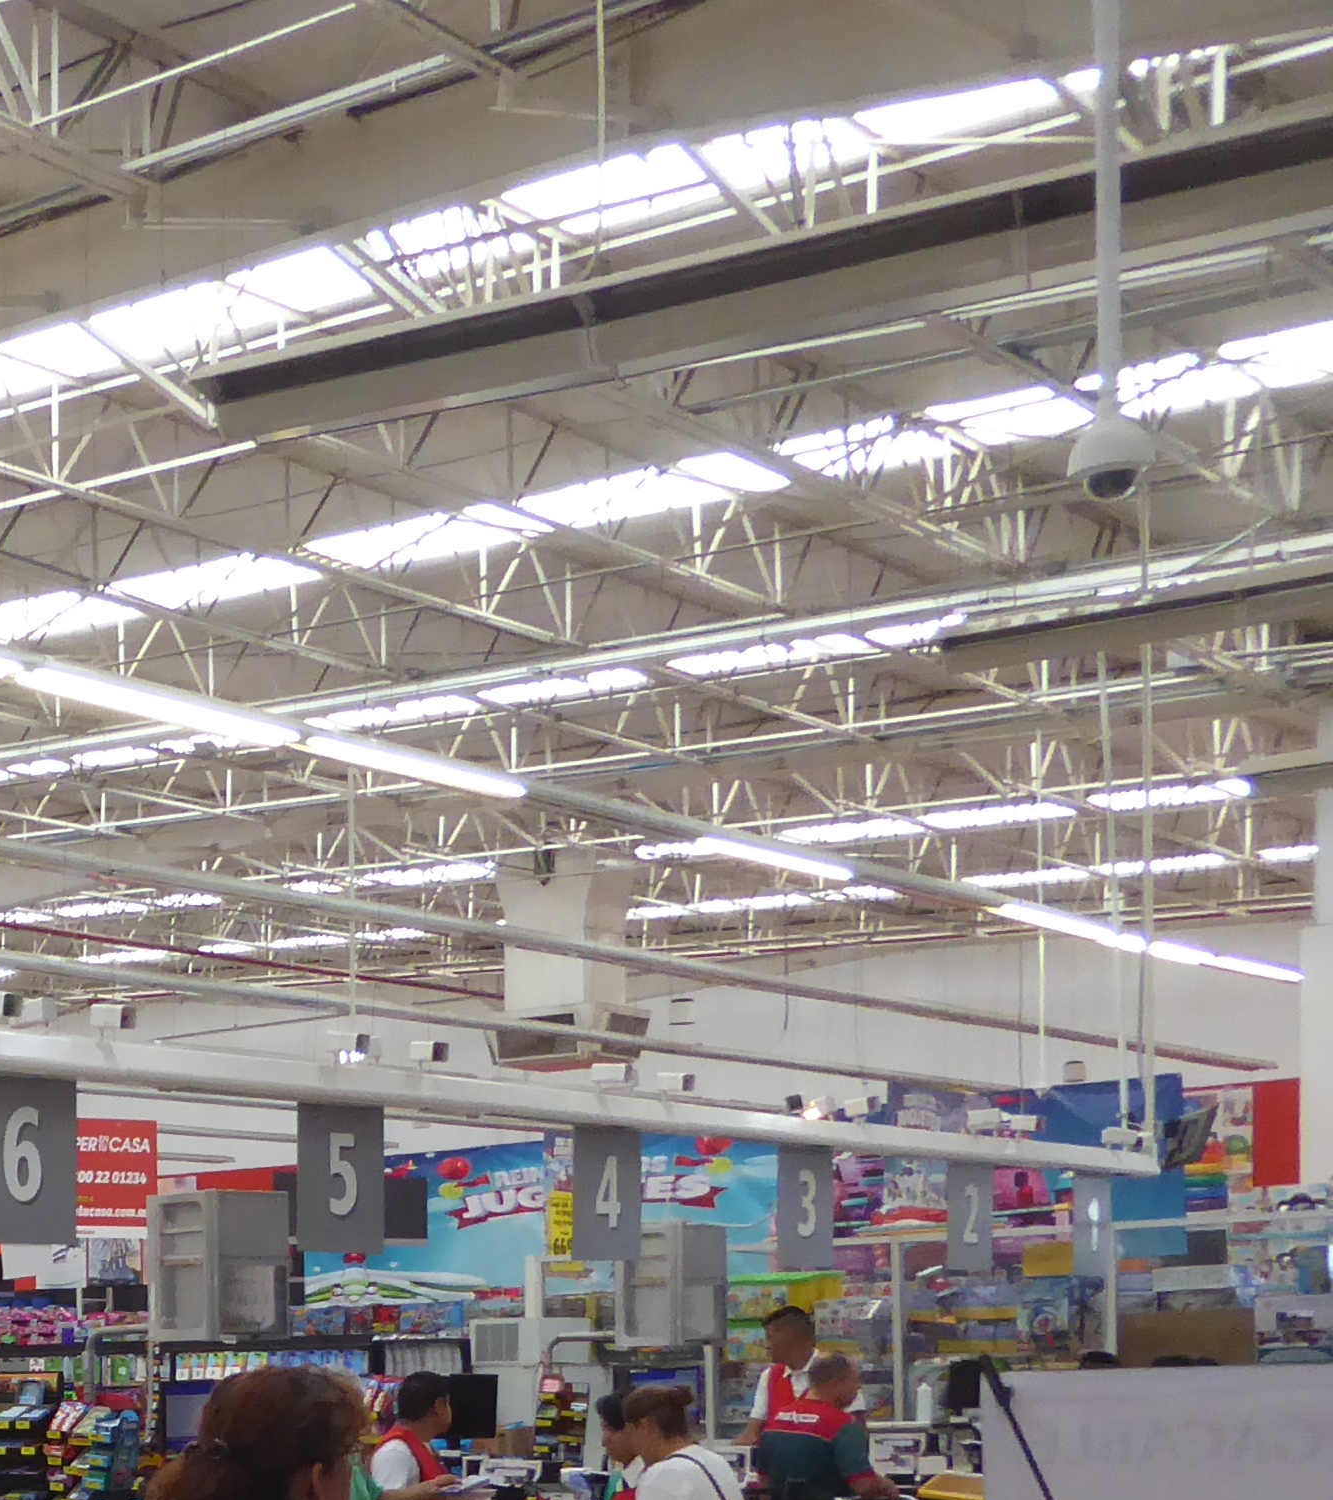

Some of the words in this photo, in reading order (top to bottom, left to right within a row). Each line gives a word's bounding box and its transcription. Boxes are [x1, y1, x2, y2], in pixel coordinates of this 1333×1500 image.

[2, 1106, 43, 1204] 6
[109, 1137, 150, 1153] CASA
[328, 1132, 358, 1217] 5
[494, 1167, 545, 1187] REIN
[595, 1155, 621, 1229] 4
[797, 1169, 816, 1239] 3
[962, 1182, 979, 1244] 2
